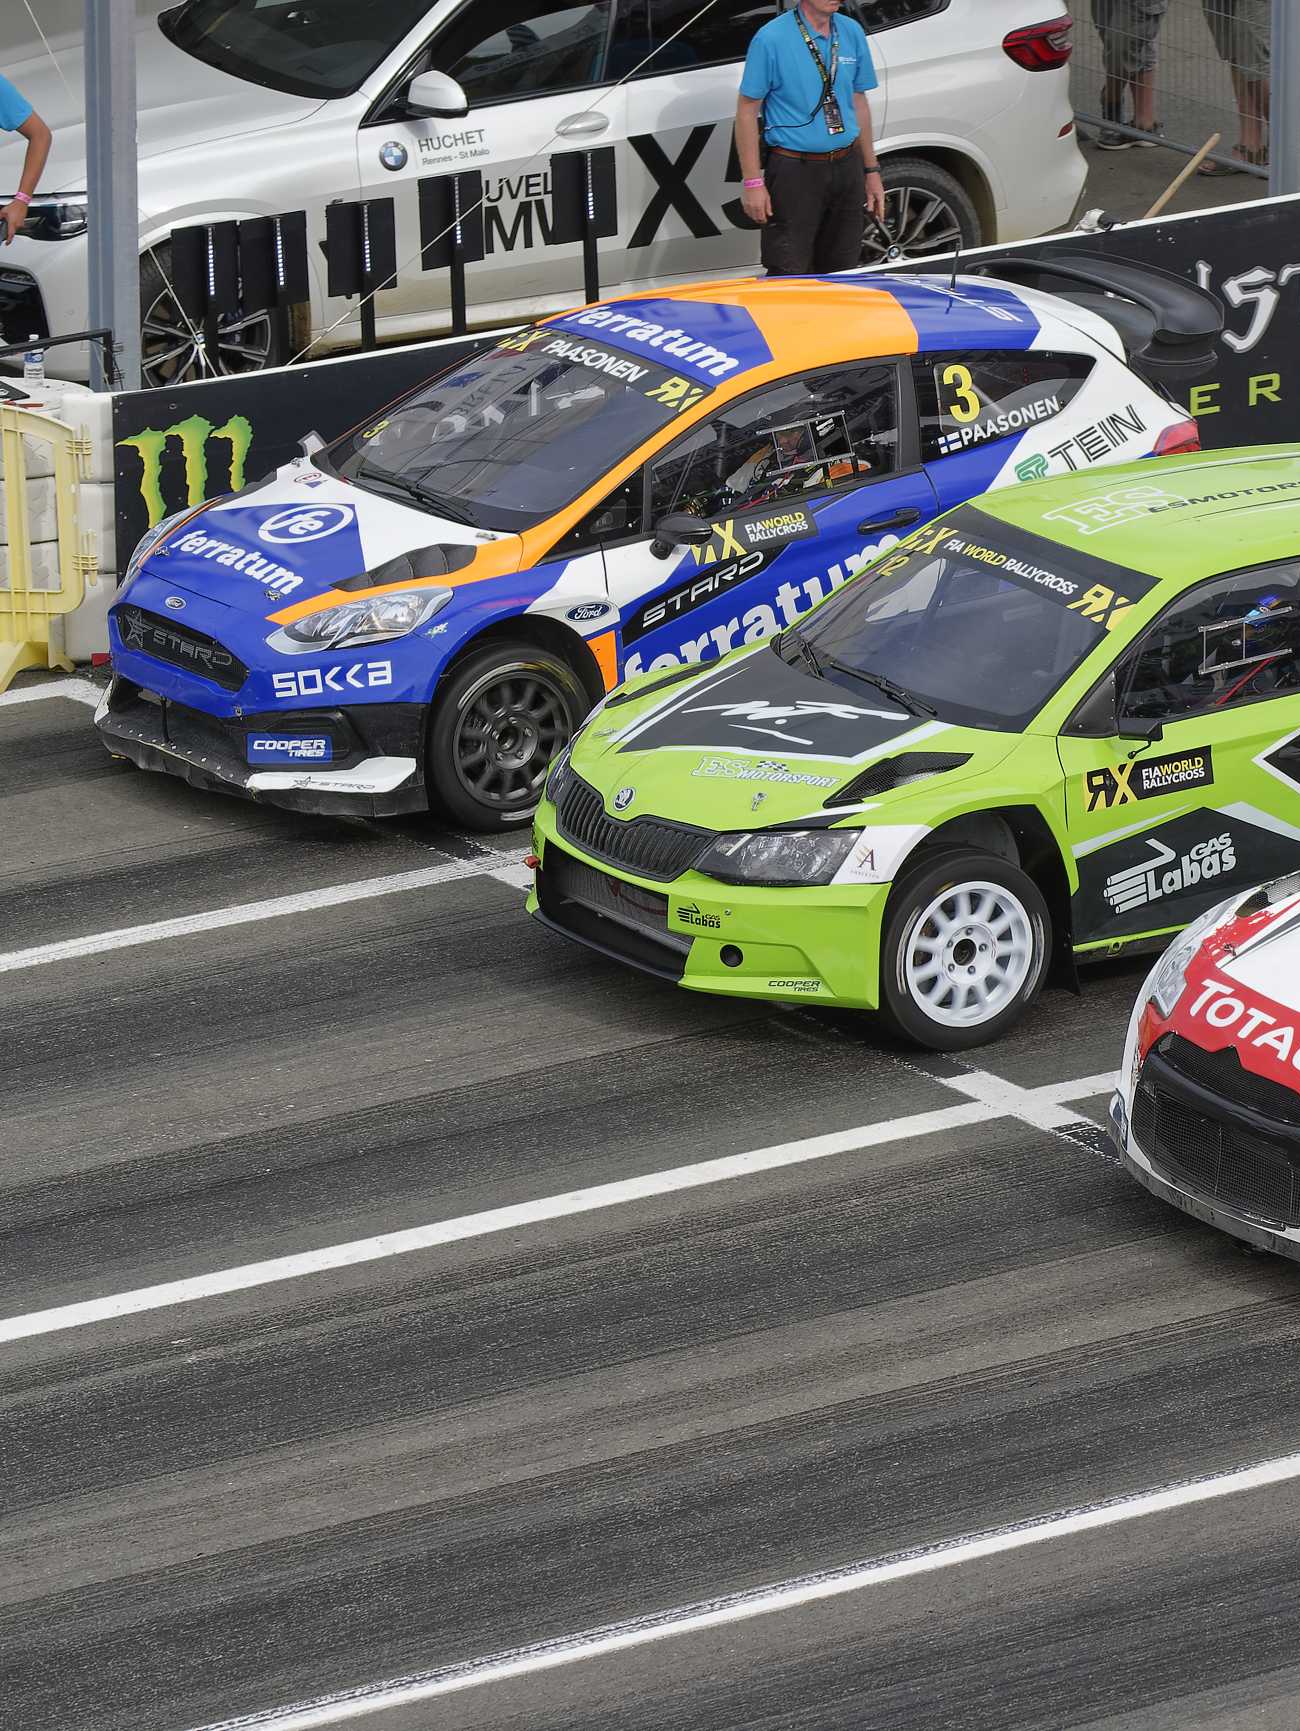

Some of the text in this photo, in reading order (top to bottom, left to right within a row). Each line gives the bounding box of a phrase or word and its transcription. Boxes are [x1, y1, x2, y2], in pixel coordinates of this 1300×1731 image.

[418, 129, 485, 153] HUCHET
[422, 154, 453, 166] Rennes
[564, 305, 741, 378] ferratum
[541, 339, 649, 383] PAASONEN
[943, 363, 982, 424] 3
[962, 395, 1062, 444] PAASONEN
[1048, 403, 1148, 472] TEIN
[747, 520, 809, 545] RALLYCROSS
[169, 529, 305, 596] ferratum
[943, 539, 1079, 595] FIA WORLD RALLYCROSS
[643, 551, 765, 629] STARD
[253, 739, 326, 751] COOPER
[288, 749, 325, 758] TIRES
[735, 769, 842, 788] MOTORSPORT
[1143, 767, 1206, 791] RALLYCROSS
[1189, 832, 1233, 861] GAS
[1148, 847, 1237, 901] Labas
[690, 914, 721, 929] Labas
[768, 980, 821, 988] COOPER
